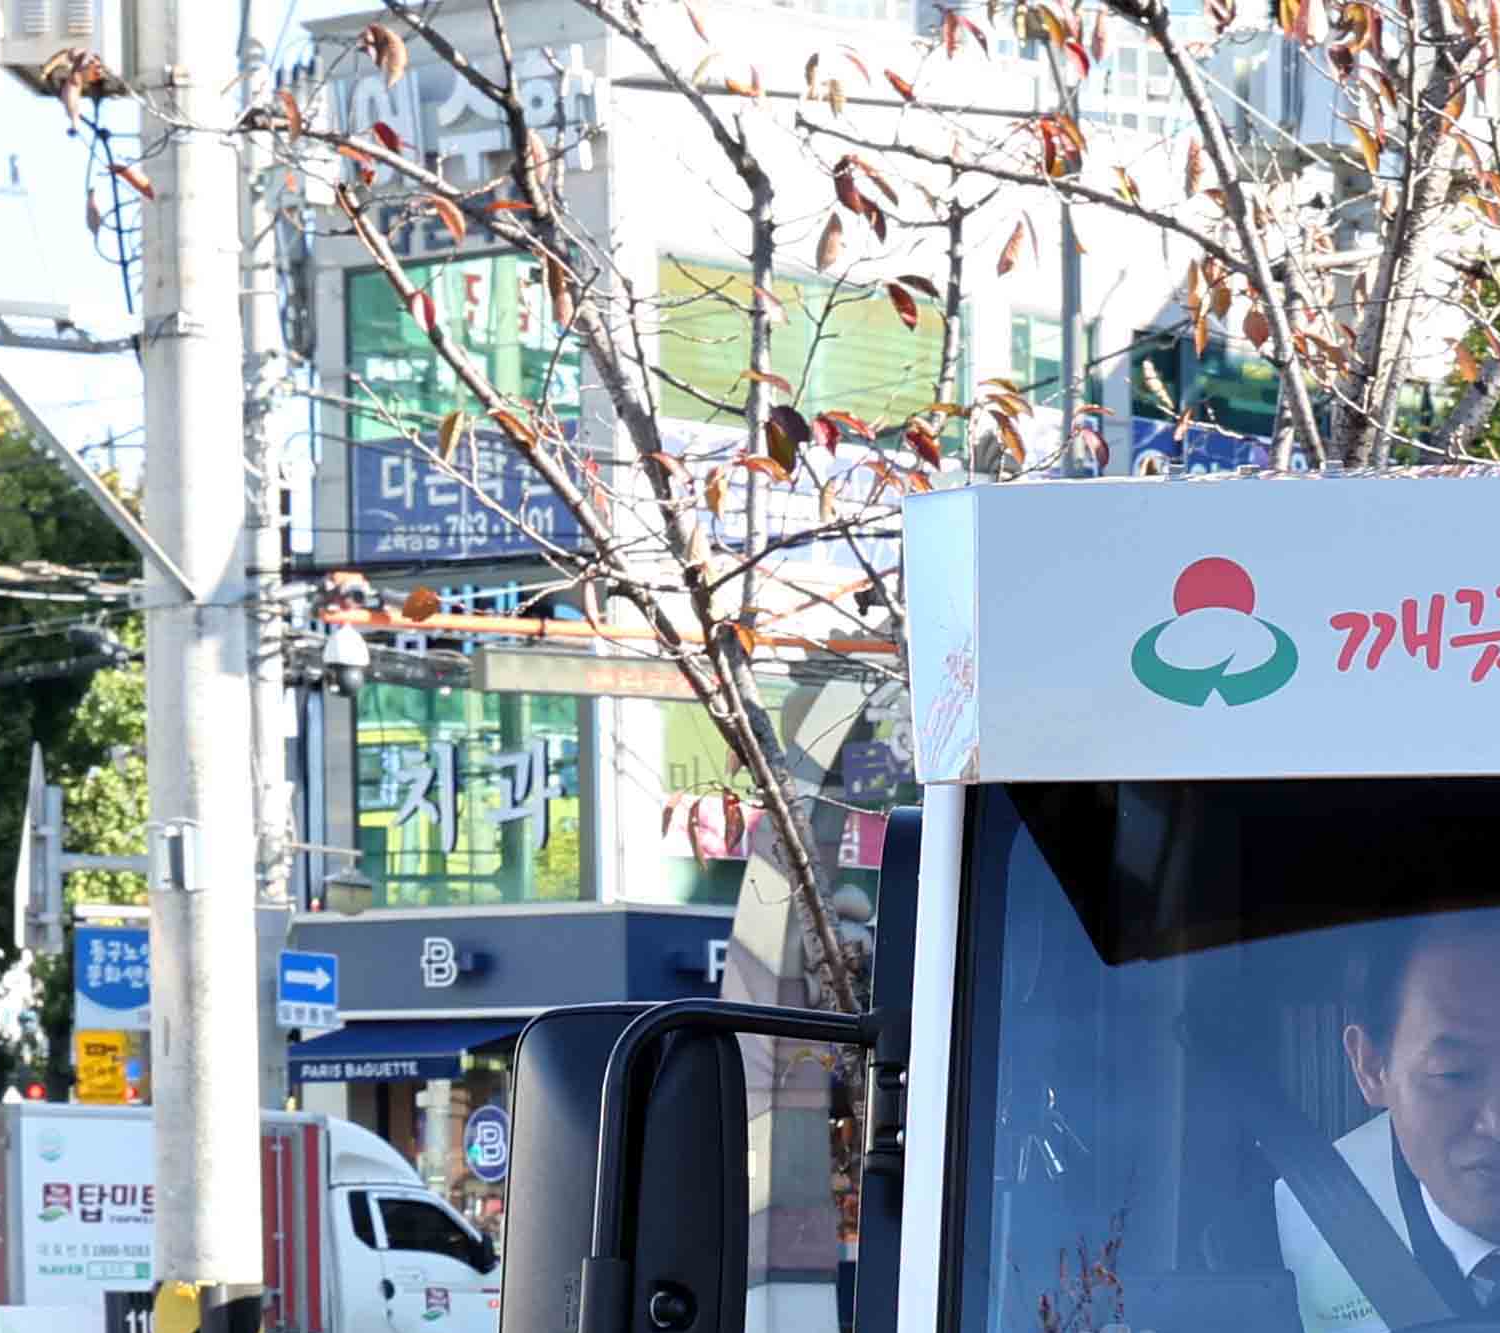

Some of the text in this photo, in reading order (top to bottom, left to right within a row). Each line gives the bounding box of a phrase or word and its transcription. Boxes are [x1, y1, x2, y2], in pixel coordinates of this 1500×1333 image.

[394, 736, 563, 854] 치과
[86, 963, 150, 989] 문화센
[421, 937, 457, 987] B
[301, 1061, 418, 1078] PARIS BAGUETTE
